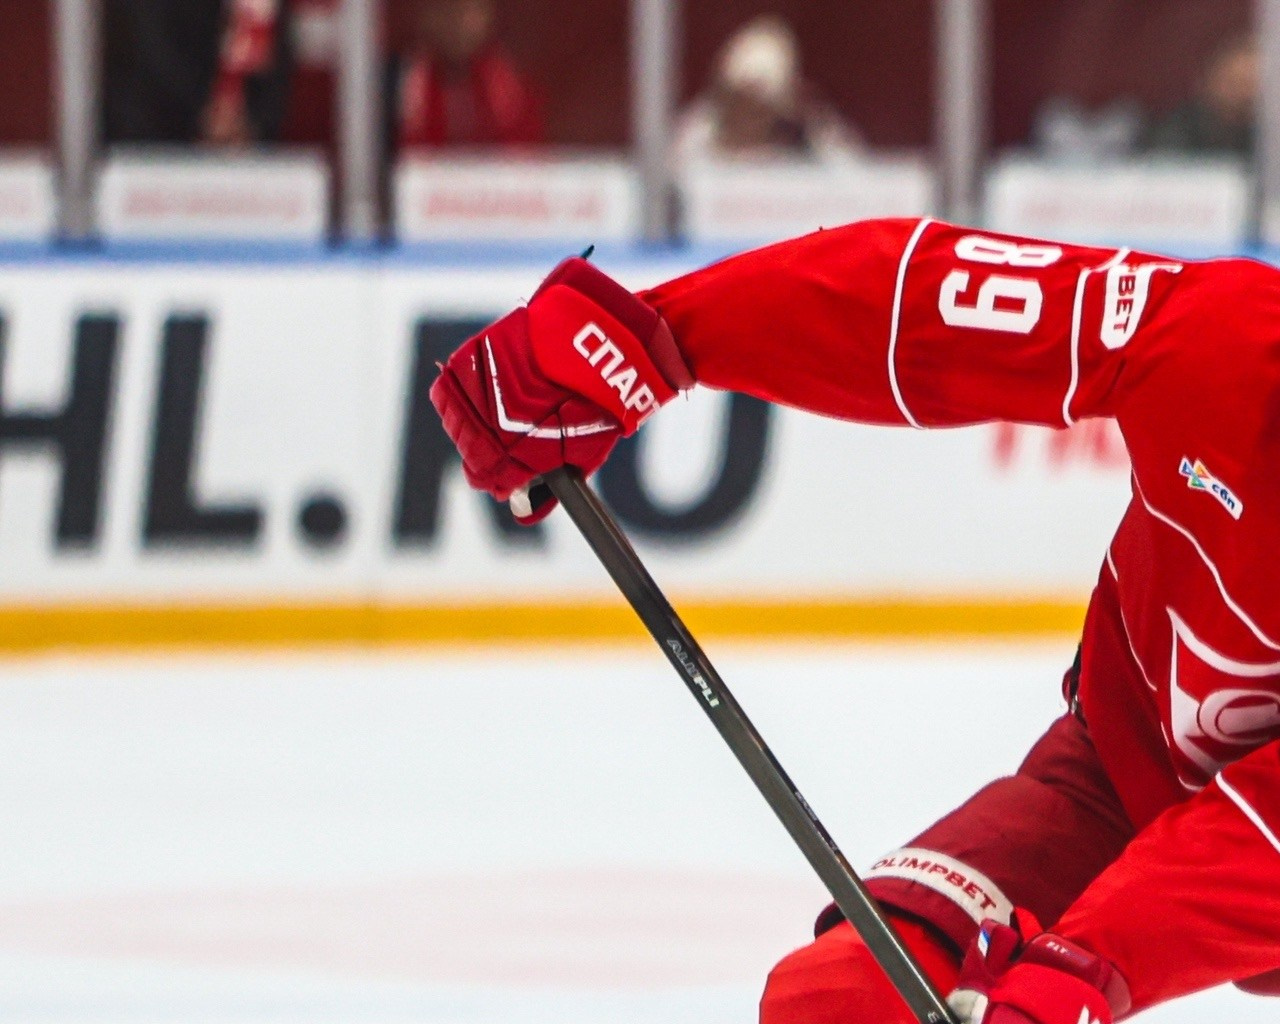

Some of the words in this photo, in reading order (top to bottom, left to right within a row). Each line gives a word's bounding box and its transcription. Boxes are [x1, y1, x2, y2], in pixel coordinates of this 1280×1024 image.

[938, 235, 1062, 334] 89
[1113, 264, 1139, 334] BET
[871, 857, 997, 910] OLIMPBET
